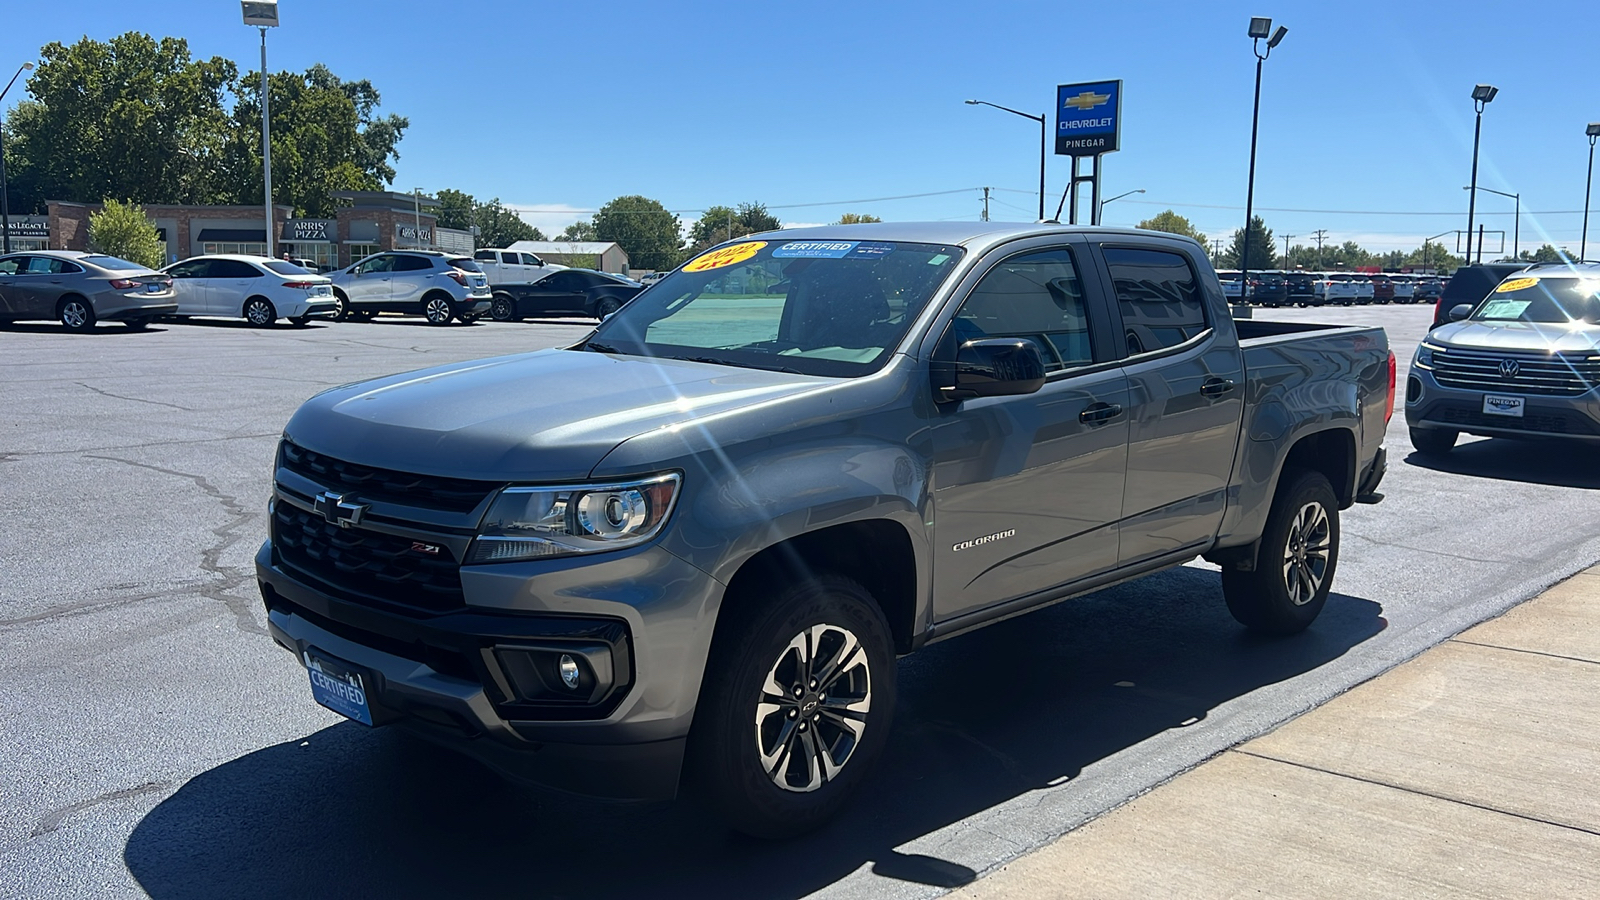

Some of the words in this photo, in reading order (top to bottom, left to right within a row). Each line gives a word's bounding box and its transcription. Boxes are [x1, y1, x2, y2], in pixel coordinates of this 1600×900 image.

[1060, 118, 1112, 130] CHEVROLET
[1065, 138, 1105, 148] PINEGAR
[293, 222, 327, 230] ARRIS'
[295, 230, 327, 239] PIZZA
[781, 243, 852, 251] CERTIFIED
[700, 244, 757, 264] 2022
[1488, 398, 1520, 406] PINEGAR
[952, 529, 1015, 551] COLORADO
[411, 541, 440, 555] Z71
[311, 670, 365, 705] CERTIFIED
